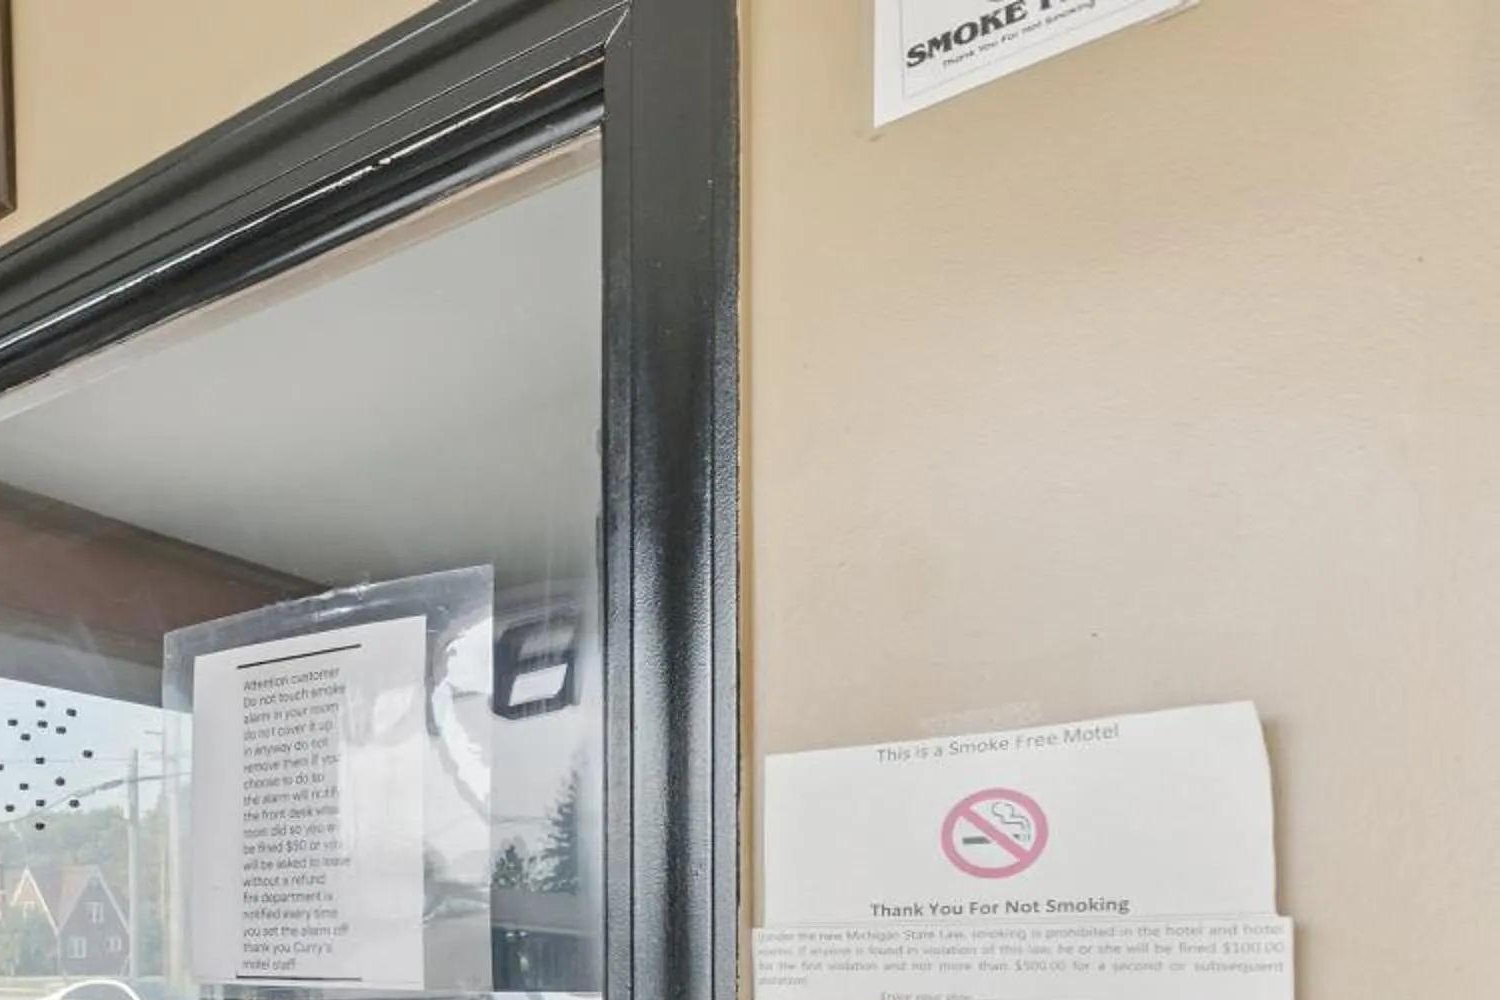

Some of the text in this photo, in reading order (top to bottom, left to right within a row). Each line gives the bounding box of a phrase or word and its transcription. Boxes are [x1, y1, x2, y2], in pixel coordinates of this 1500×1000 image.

[906, 0, 1028, 68] SMOKE
[259, 694, 276, 706] not
[876, 722, 1121, 764] This is a Smoke Free Motel
[870, 896, 1131, 920] Thank You For Not Smoking
